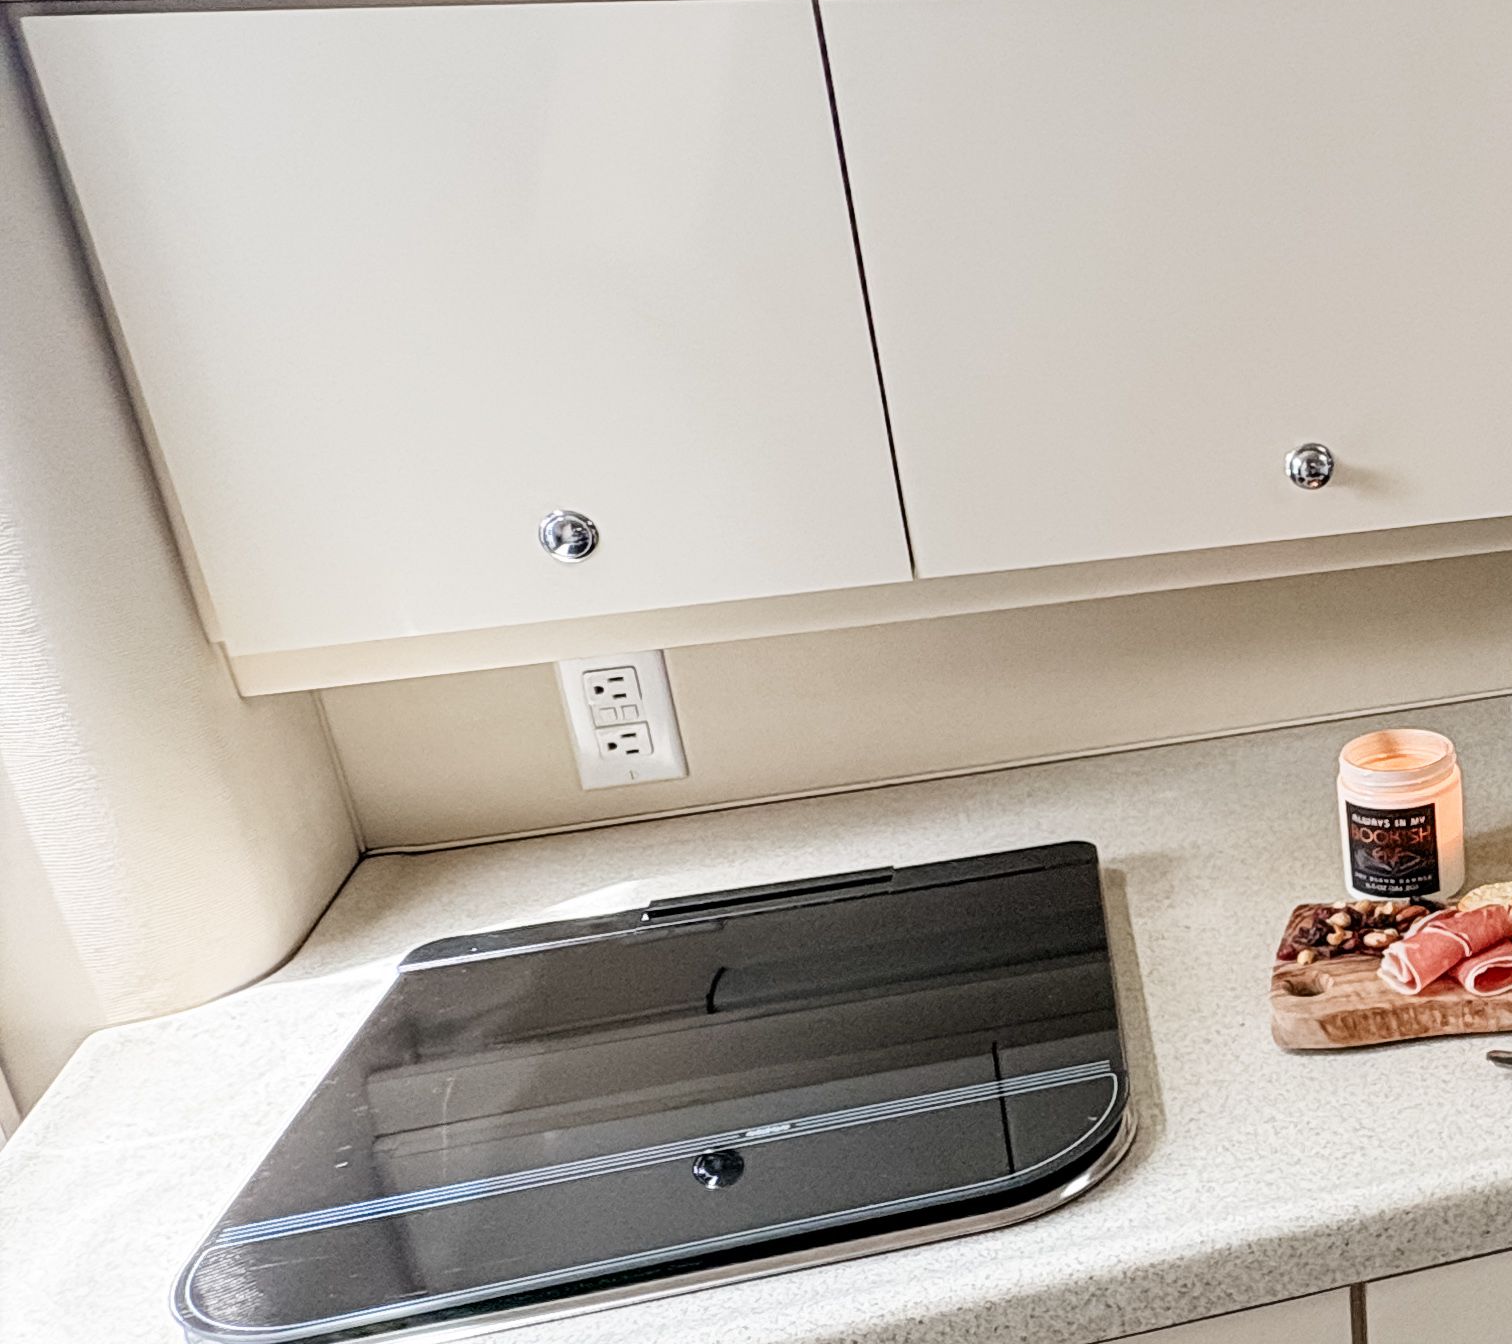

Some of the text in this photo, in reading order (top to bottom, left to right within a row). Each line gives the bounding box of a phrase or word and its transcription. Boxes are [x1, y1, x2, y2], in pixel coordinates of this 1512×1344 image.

[1351, 813, 1426, 828] ALWAYS IN MY
